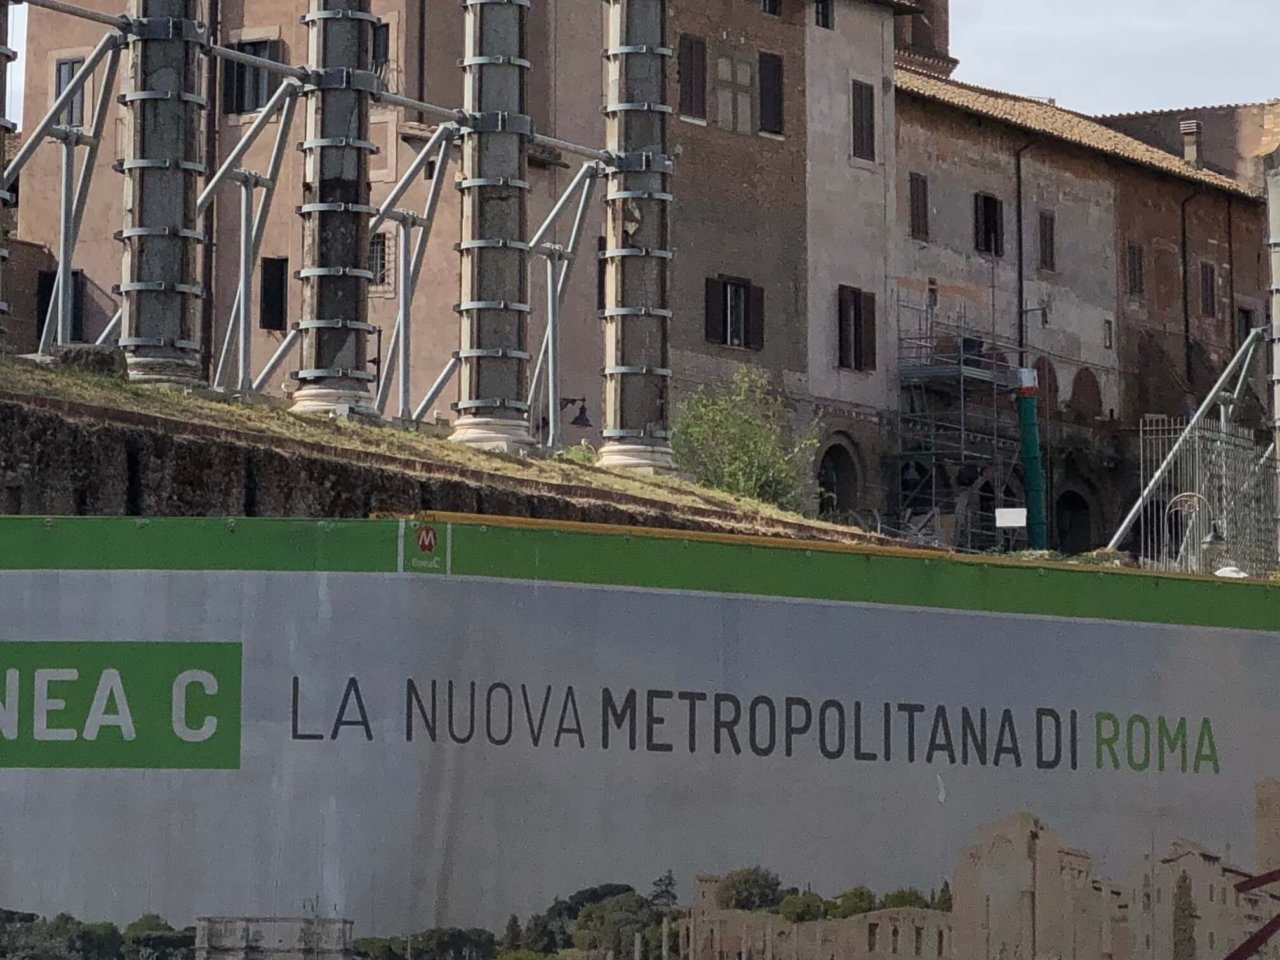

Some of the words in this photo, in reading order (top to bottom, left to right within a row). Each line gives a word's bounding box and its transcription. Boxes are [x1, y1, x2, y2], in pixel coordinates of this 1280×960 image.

[172, 669, 219, 742] C
[292, 676, 373, 741] LA
[405, 677, 585, 749] NUOVA
[601, 686, 1022, 768] METROPOLITANA
[1036, 707, 1078, 771] DI
[1095, 711, 1221, 775] ROMA
